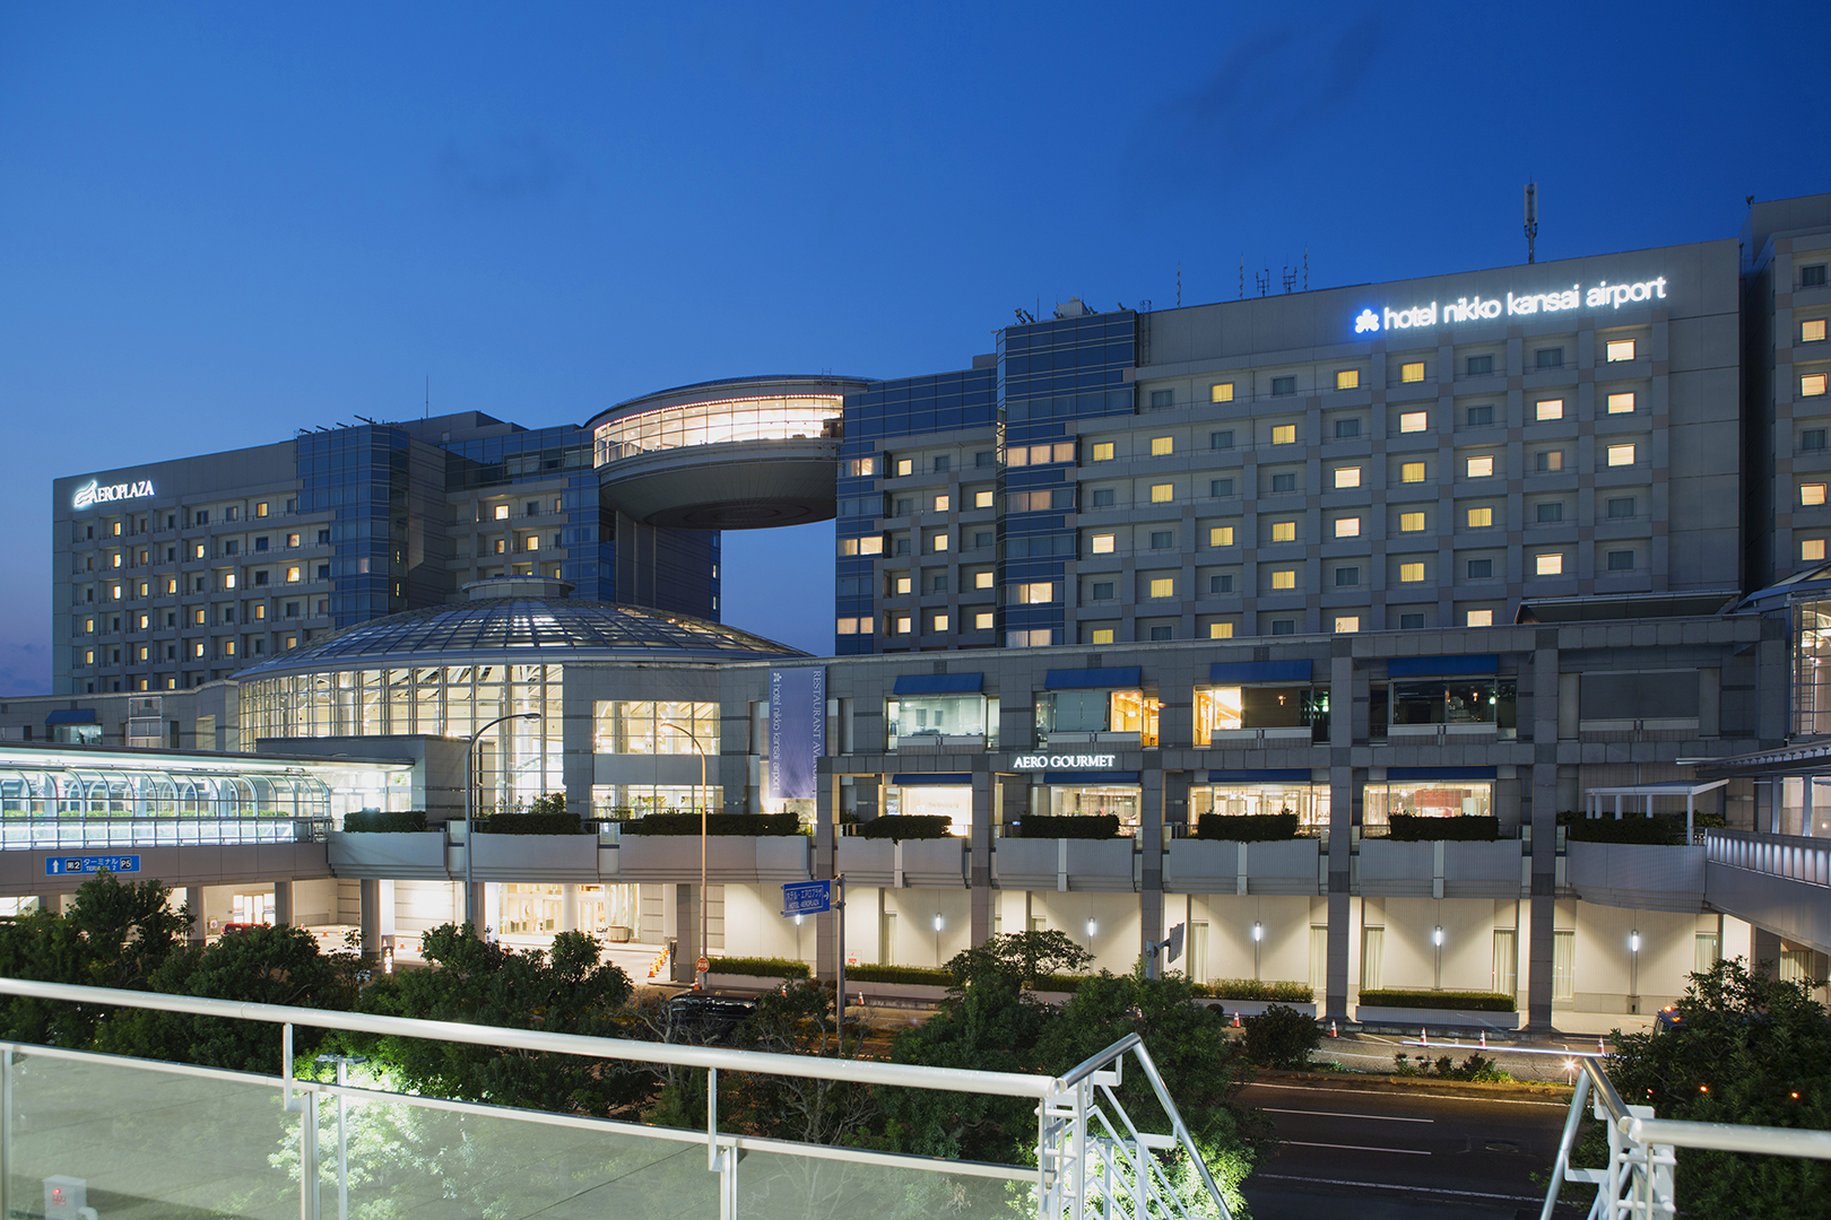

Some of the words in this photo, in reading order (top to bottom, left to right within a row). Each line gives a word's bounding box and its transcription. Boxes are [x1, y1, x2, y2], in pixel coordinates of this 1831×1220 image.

[1383, 301, 1436, 330] hotel
[1443, 296, 1502, 324] nikko
[1507, 284, 1580, 315] kansai
[1586, 276, 1667, 309] airport
[91, 480, 155, 503] AEROPLAZA
[773, 684, 781, 705] hotel
[812, 670, 821, 739] RESTAURANT
[773, 709, 781, 731] nikko
[773, 732, 781, 759] kansai
[1013, 756, 1048, 768] AERO
[1050, 755, 1116, 768] GOURMET
[771, 761, 780, 791] airport
[83, 858, 119, 866] ターミナル
